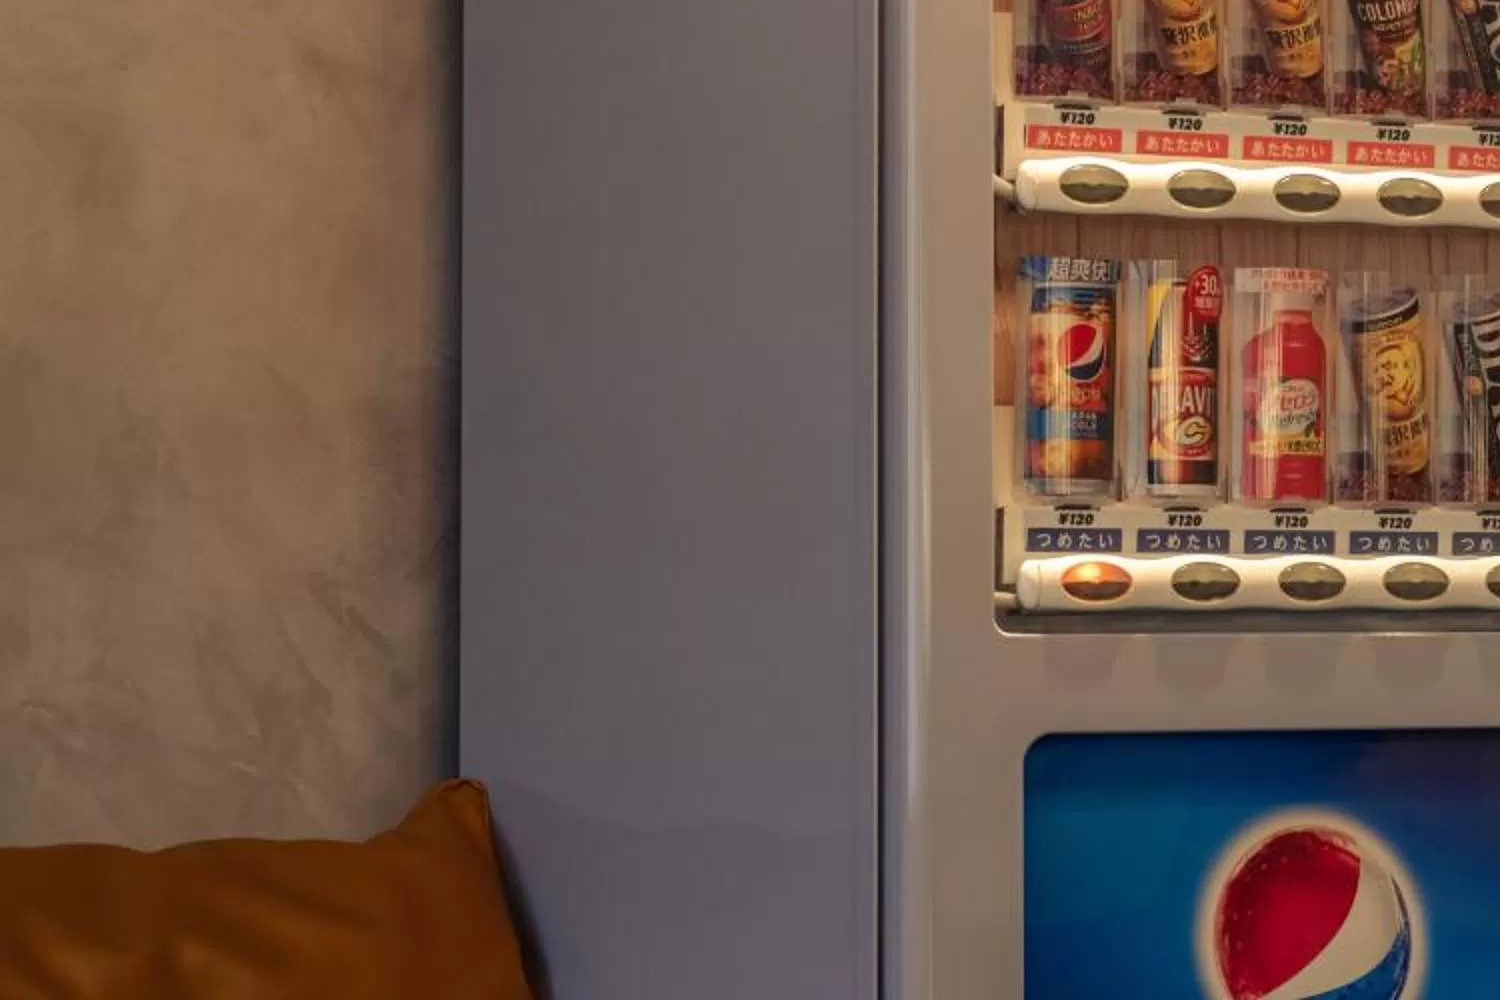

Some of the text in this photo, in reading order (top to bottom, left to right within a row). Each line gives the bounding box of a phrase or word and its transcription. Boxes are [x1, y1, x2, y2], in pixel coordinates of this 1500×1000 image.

[1060, 112, 1095, 125] ¥120
[1168, 118, 1203, 131] ¥120
[1274, 123, 1308, 136] ¥120
[1376, 128, 1411, 142] ¥120
[1037, 128, 1114, 149] あたたかい
[1146, 134, 1221, 153] あたたかい
[1251, 139, 1325, 159] あたたかい
[1354, 145, 1427, 164] あたたかい
[1058, 513, 1094, 526] ¥120
[1167, 514, 1203, 527] ¥120
[1274, 516, 1309, 528] ¥120
[1378, 517, 1413, 530] ¥120
[1035, 533, 1114, 550] つめたい
[1145, 534, 1222, 550] つめたい
[1252, 535, 1328, 551] つめたい
[1358, 536, 1430, 552] つめたい
